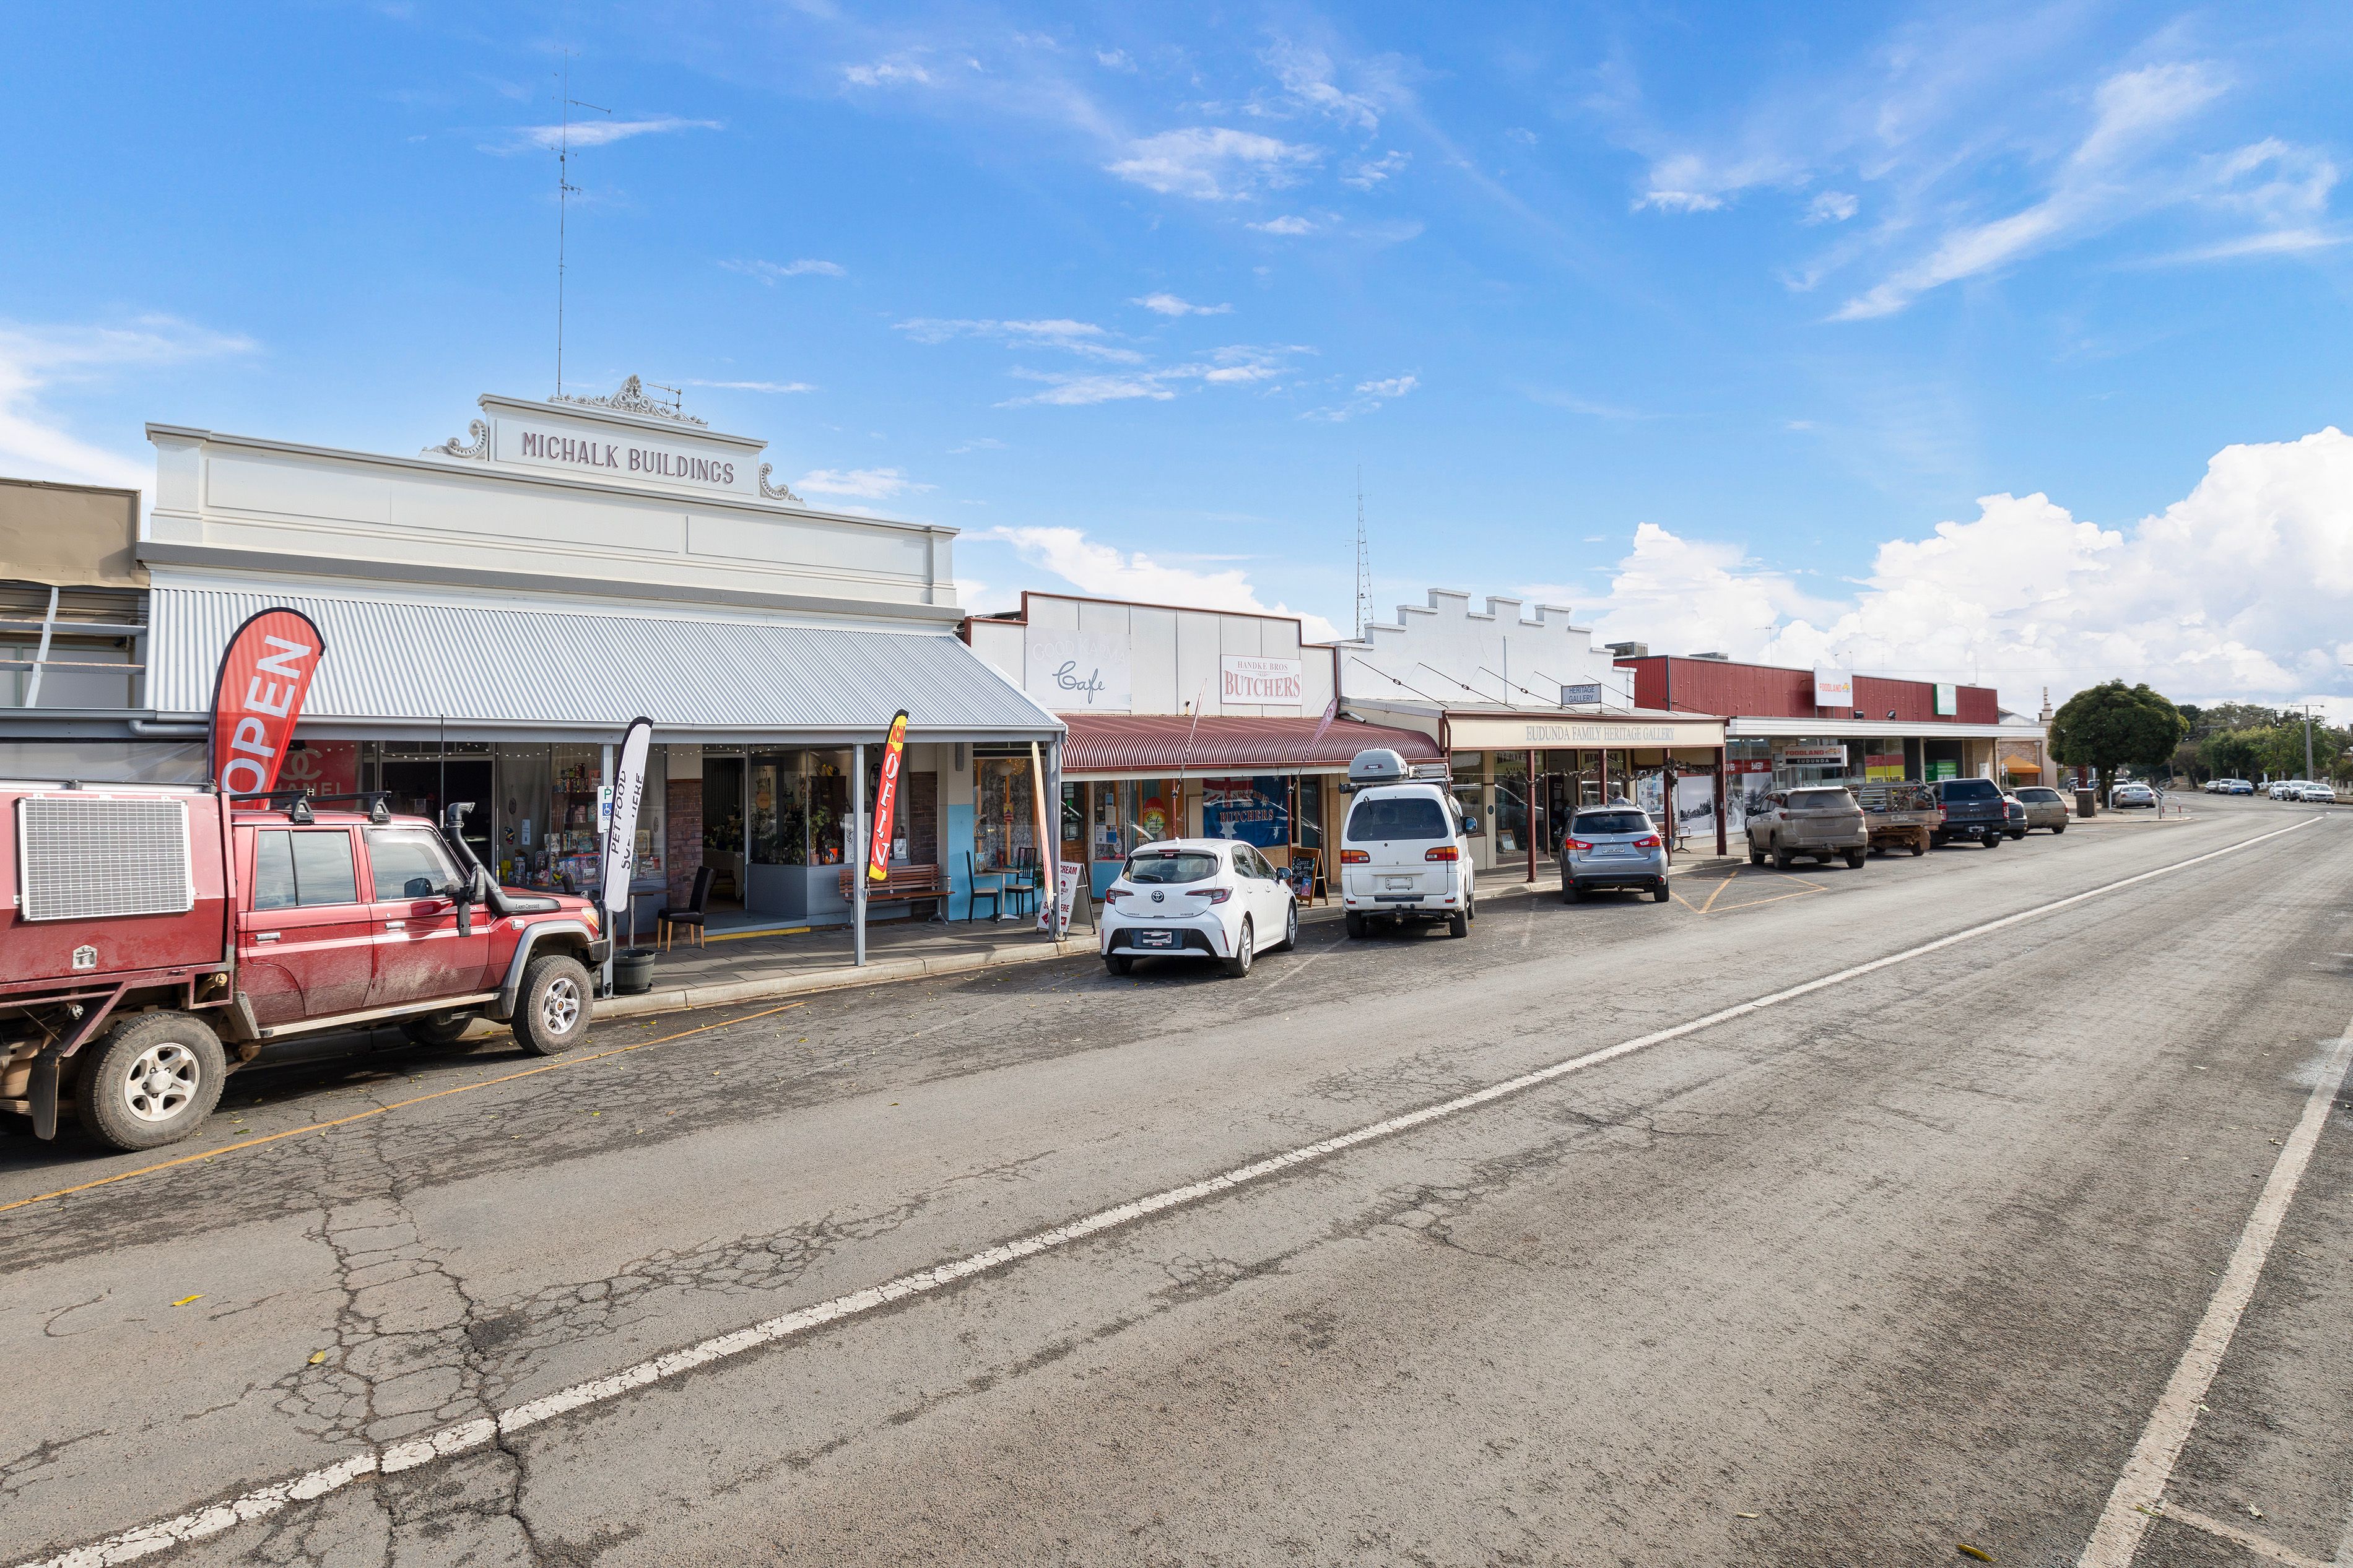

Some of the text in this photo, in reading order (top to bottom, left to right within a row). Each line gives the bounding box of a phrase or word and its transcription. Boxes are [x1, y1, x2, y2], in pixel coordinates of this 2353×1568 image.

[522, 431, 734, 485] MICHALK BUILDINGS
[1033, 638, 1126, 666] GOOD KARMA
[1238, 661, 1289, 671] HANDKE BROS
[1051, 660, 1106, 704] Cafe
[1224, 670, 1300, 699] BUTCHERS
[1569, 685, 1595, 694] HERITAGE
[1819, 683, 1842, 693] FOODLAND
[1568, 695, 1594, 703] GALLERY
[221, 635, 313, 802] OPEN
[1526, 726, 1675, 741] EUDUNDA FAMILY HERITAGE GALLERY
[604, 789, 612, 800] P
[611, 770, 626, 854] PET FOOD
[1219, 808, 1274, 823] BUTCHERS
[1297, 858, 1310, 866] COFFEE
[1061, 904, 1069, 912] ERE
